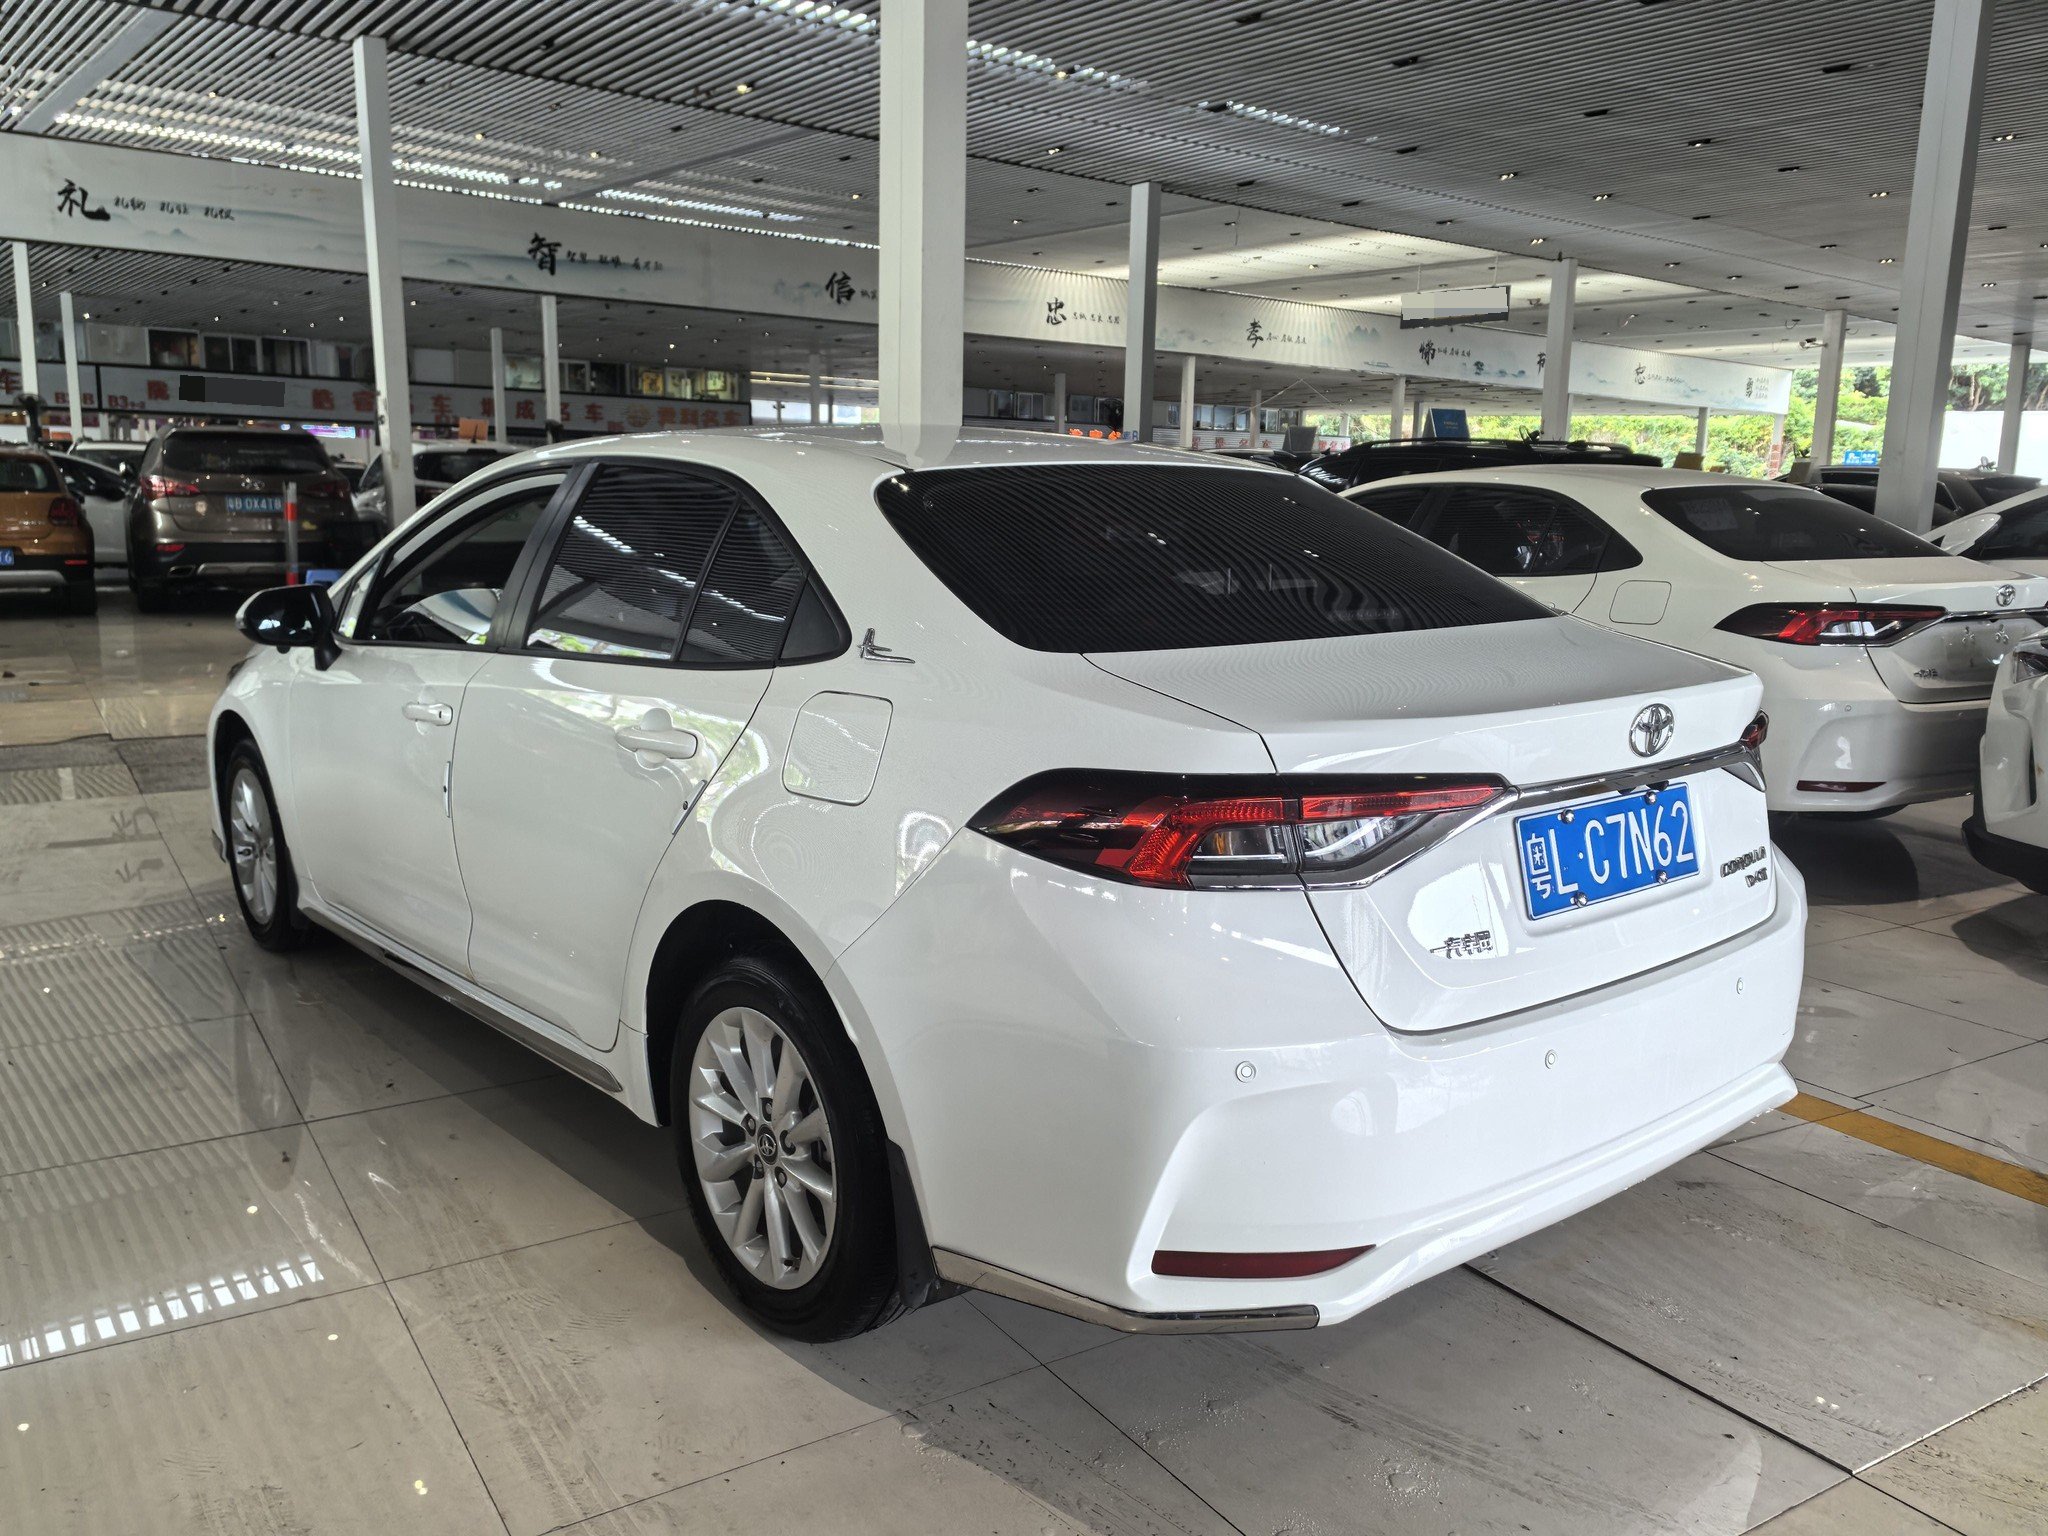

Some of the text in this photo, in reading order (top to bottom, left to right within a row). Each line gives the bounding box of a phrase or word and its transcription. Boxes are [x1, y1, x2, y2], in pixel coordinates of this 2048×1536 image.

[57, 178, 111, 222] 礼
[527, 231, 563, 277] 智
[824, 270, 857, 306] 信
[1045, 296, 1068, 326] 忠
[1526, 800, 1694, 900] 粤L·C7N62
